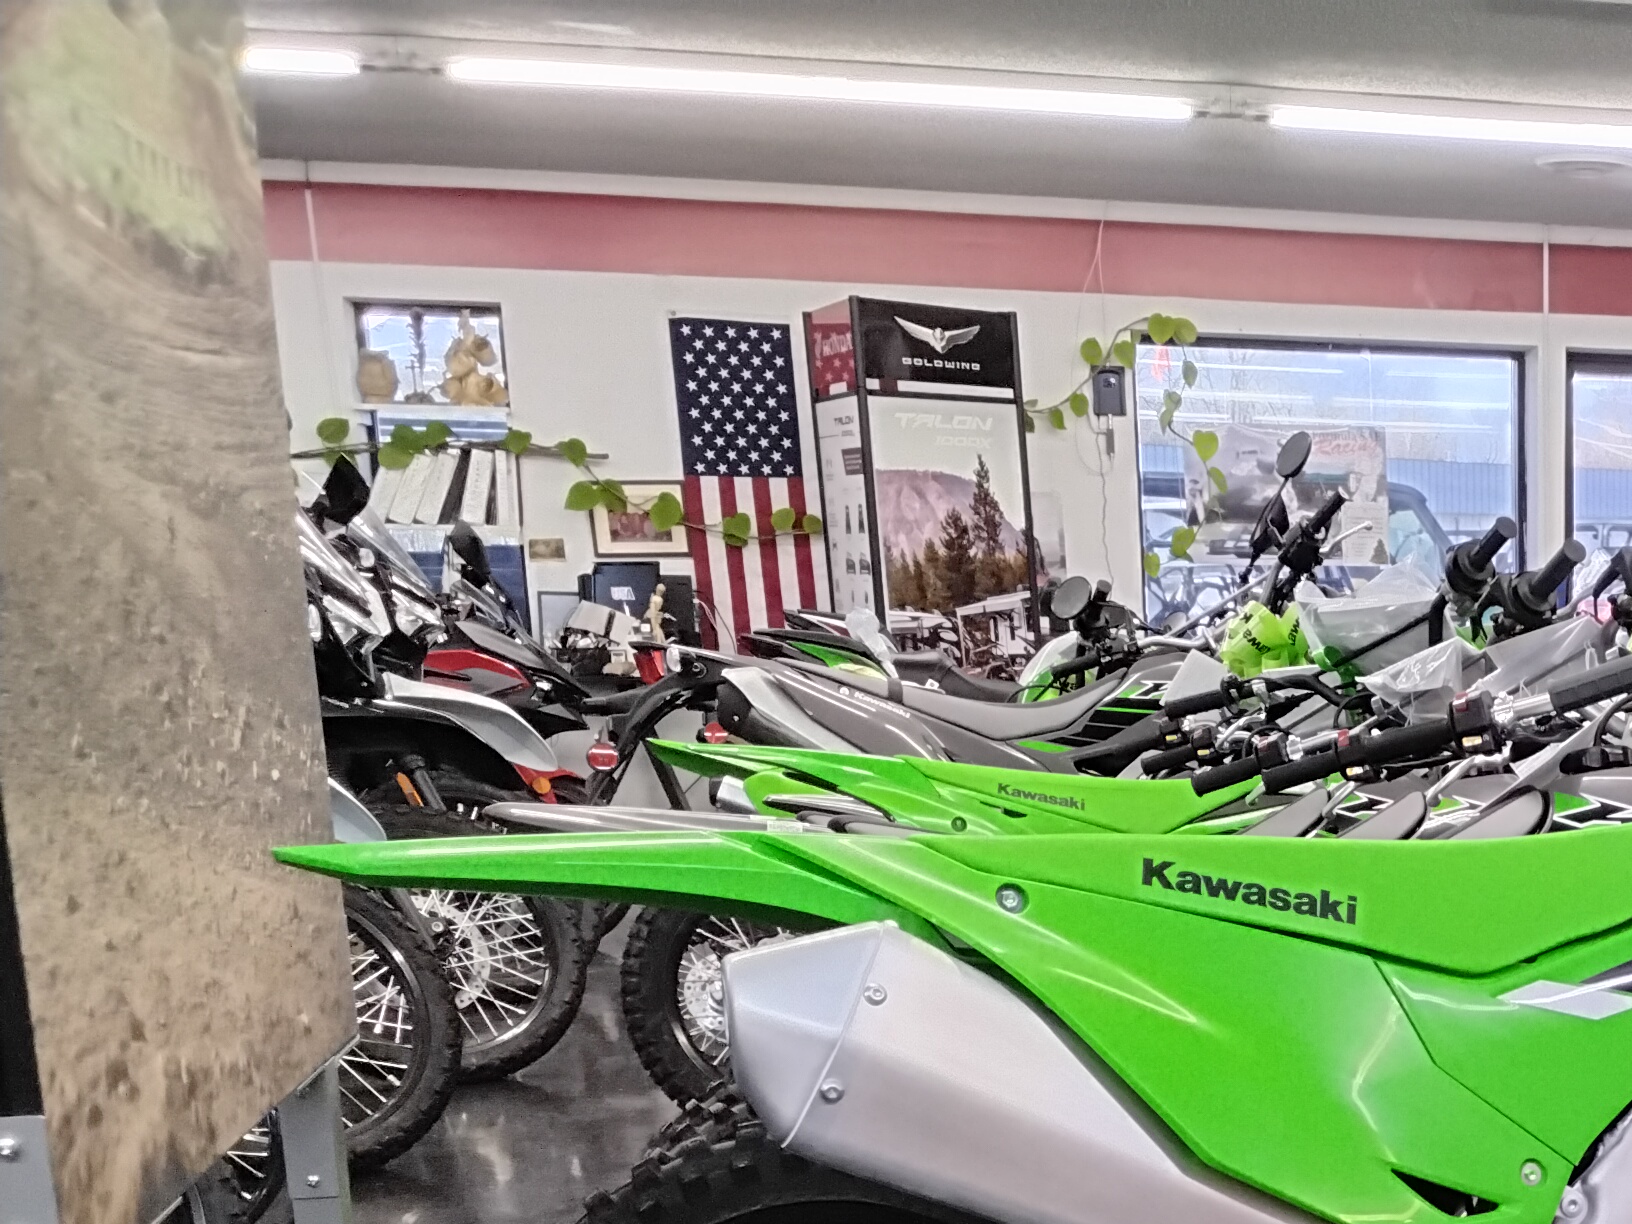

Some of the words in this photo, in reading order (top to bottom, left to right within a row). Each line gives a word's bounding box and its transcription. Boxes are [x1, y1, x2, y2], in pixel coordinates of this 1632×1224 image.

[901, 357, 981, 371] GOLDWING
[894, 412, 993, 431] TALON
[997, 782, 1086, 811] Kawasaki
[1141, 857, 1358, 926] Kawasaki
